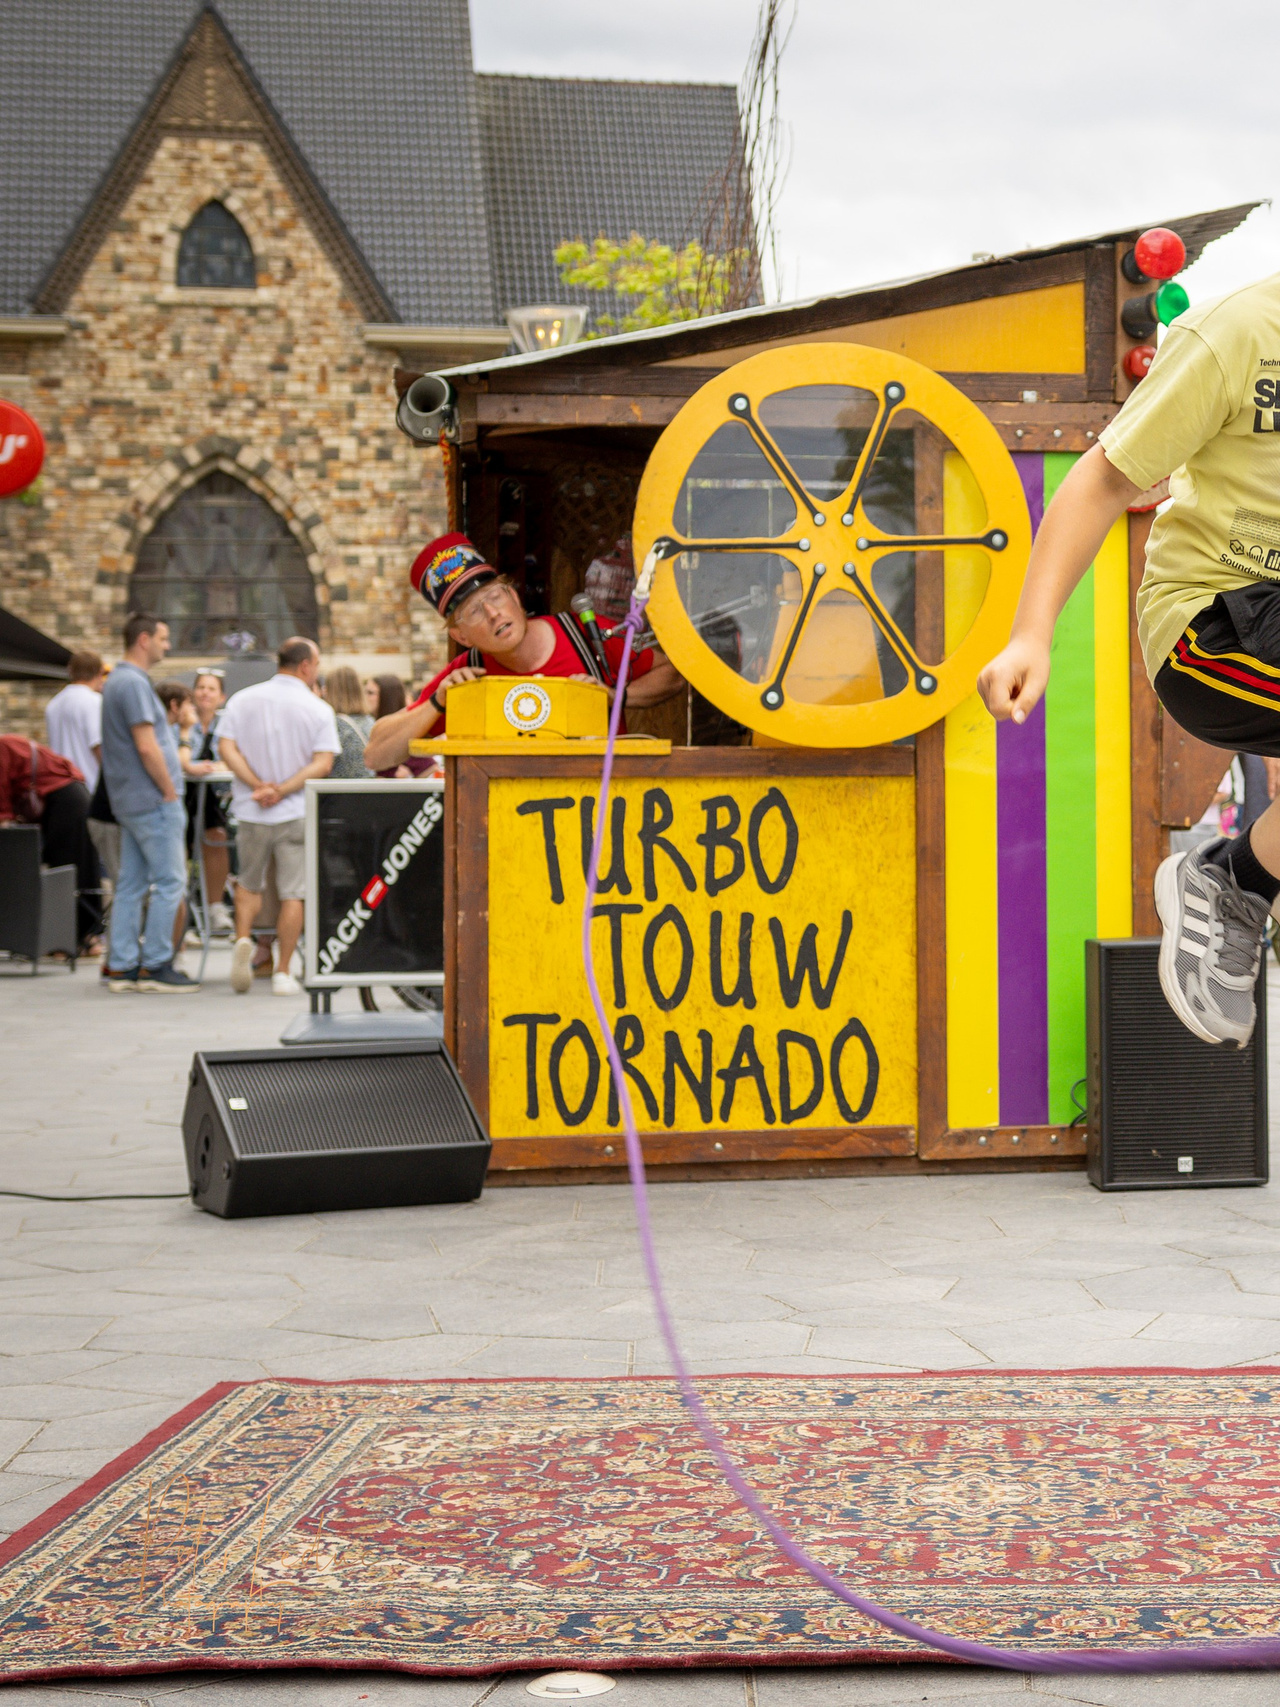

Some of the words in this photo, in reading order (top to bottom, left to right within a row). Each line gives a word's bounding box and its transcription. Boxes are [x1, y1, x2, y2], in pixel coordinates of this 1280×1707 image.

[318, 898, 373, 975] JACK
[382, 794, 444, 885] JONES
[516, 787, 799, 904] TURBO
[591, 904, 853, 1011] TOUW
[502, 1014, 880, 1127] TORNADO
